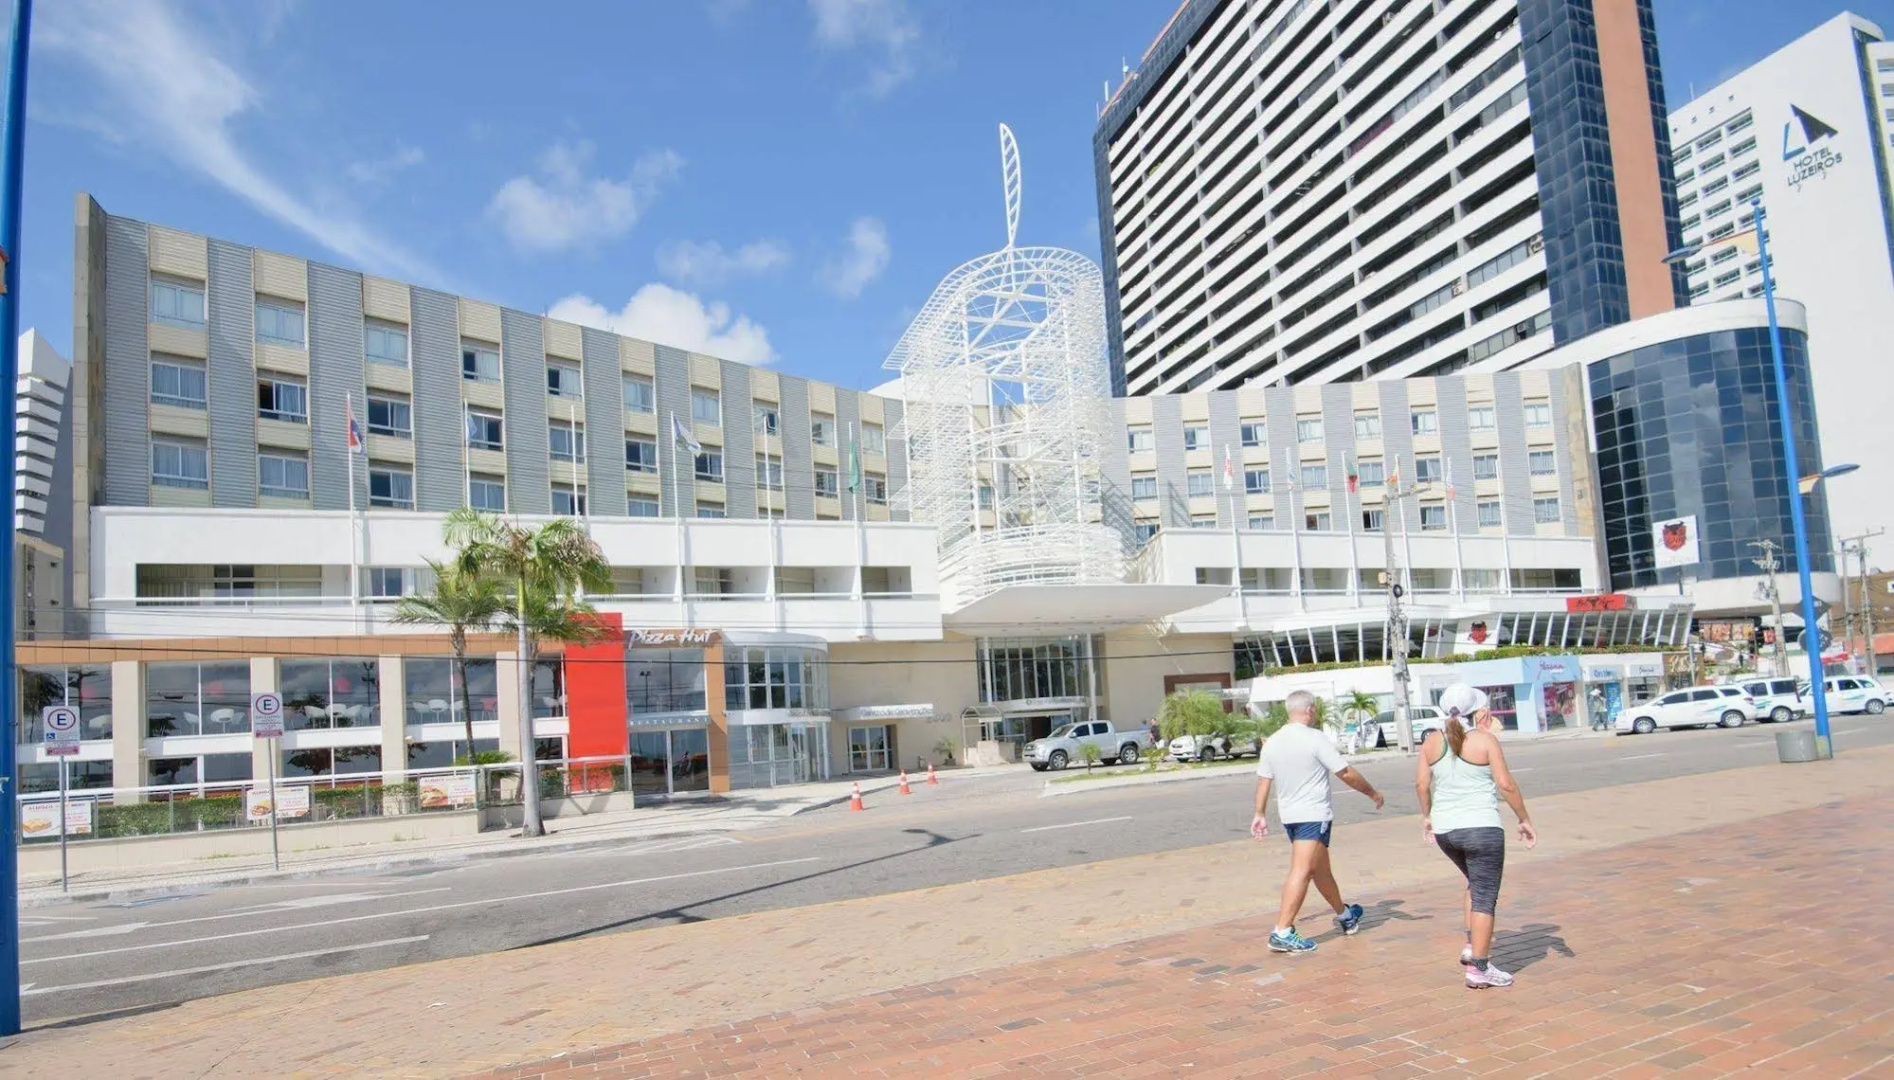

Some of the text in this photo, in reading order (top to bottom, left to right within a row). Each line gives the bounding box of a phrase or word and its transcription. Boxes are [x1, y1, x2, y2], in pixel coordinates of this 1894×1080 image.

[1787, 152, 1843, 187] LUZEIROS
[1793, 147, 1833, 171] HOTEL
[628, 628, 718, 652] Pizza Hut
[263, 698, 273, 711] E
[56, 713, 67, 726] E
